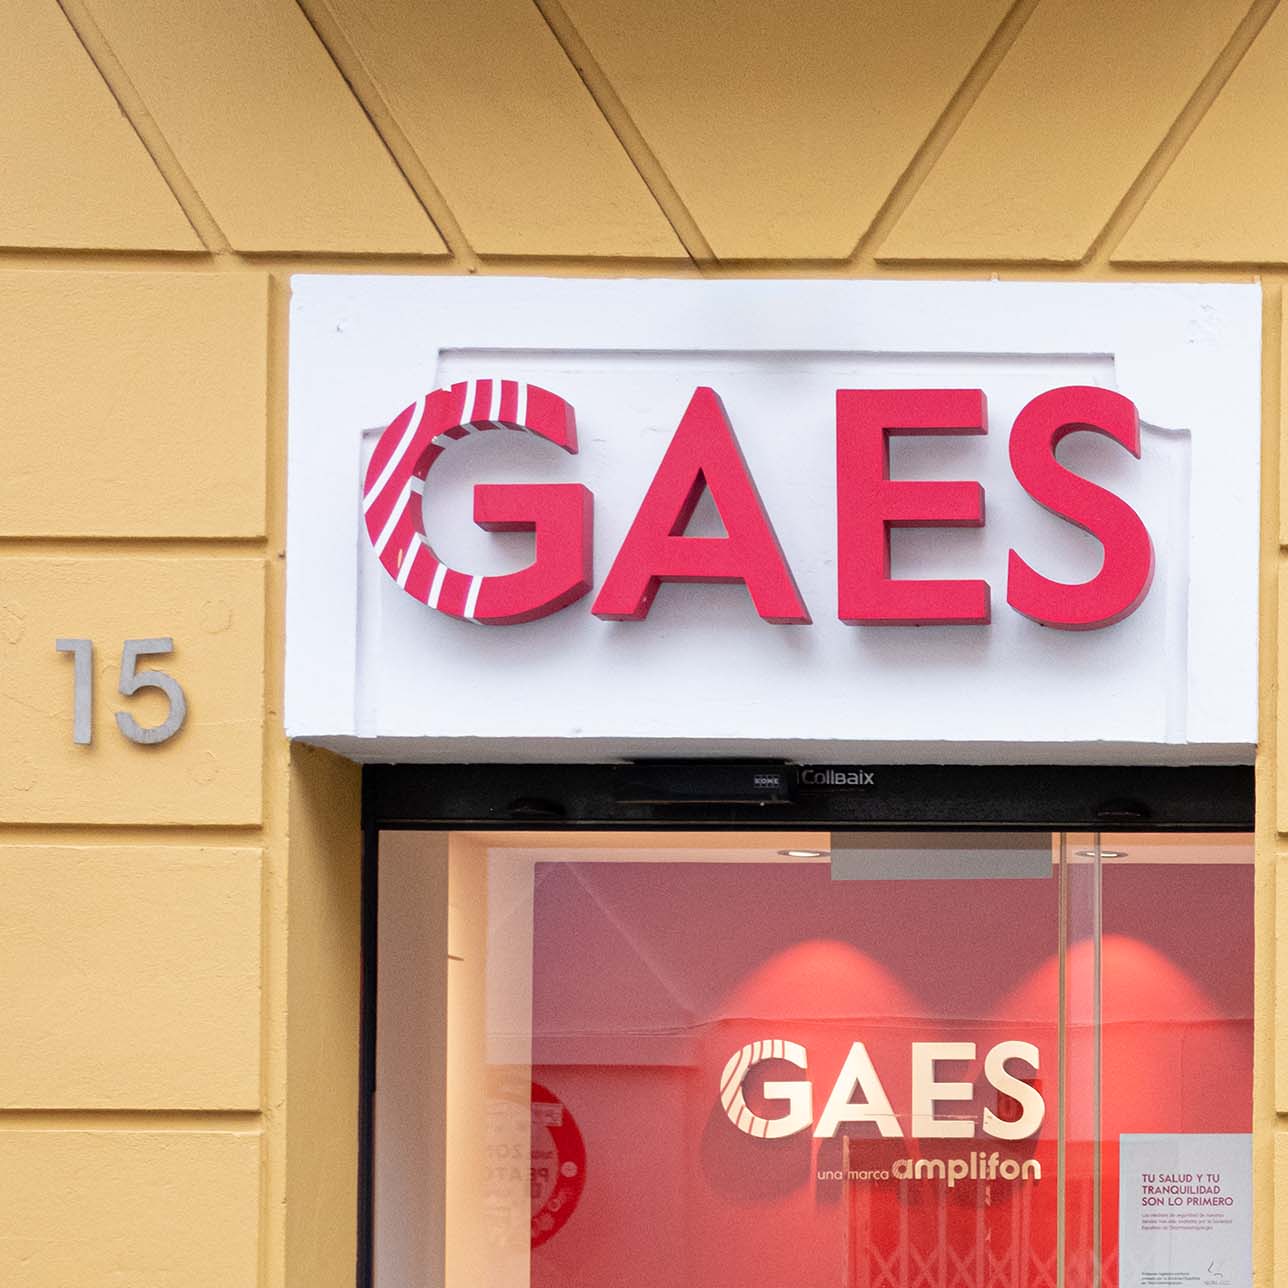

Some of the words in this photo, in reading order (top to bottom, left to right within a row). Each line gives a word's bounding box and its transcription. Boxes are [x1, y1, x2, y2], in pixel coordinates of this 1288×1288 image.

[363, 379, 1156, 632] GAES
[56, 638, 188, 746] 15
[720, 1040, 1045, 1140] GAES
[817, 1169, 843, 1180] una
[848, 1169, 889, 1180] marca
[892, 1151, 1041, 1187] amplifon
[1142, 1174, 1155, 1183] TU
[1159, 1174, 1193, 1183] SALUD
[1196, 1174, 1203, 1183] Y
[1207, 1174, 1220, 1183] TU
[1142, 1186, 1220, 1195] TRANQUILIDAD
[1142, 1197, 1164, 1206] SON
[1168, 1197, 1183, 1206] LO
[1187, 1197, 1234, 1206] PRIMERO
